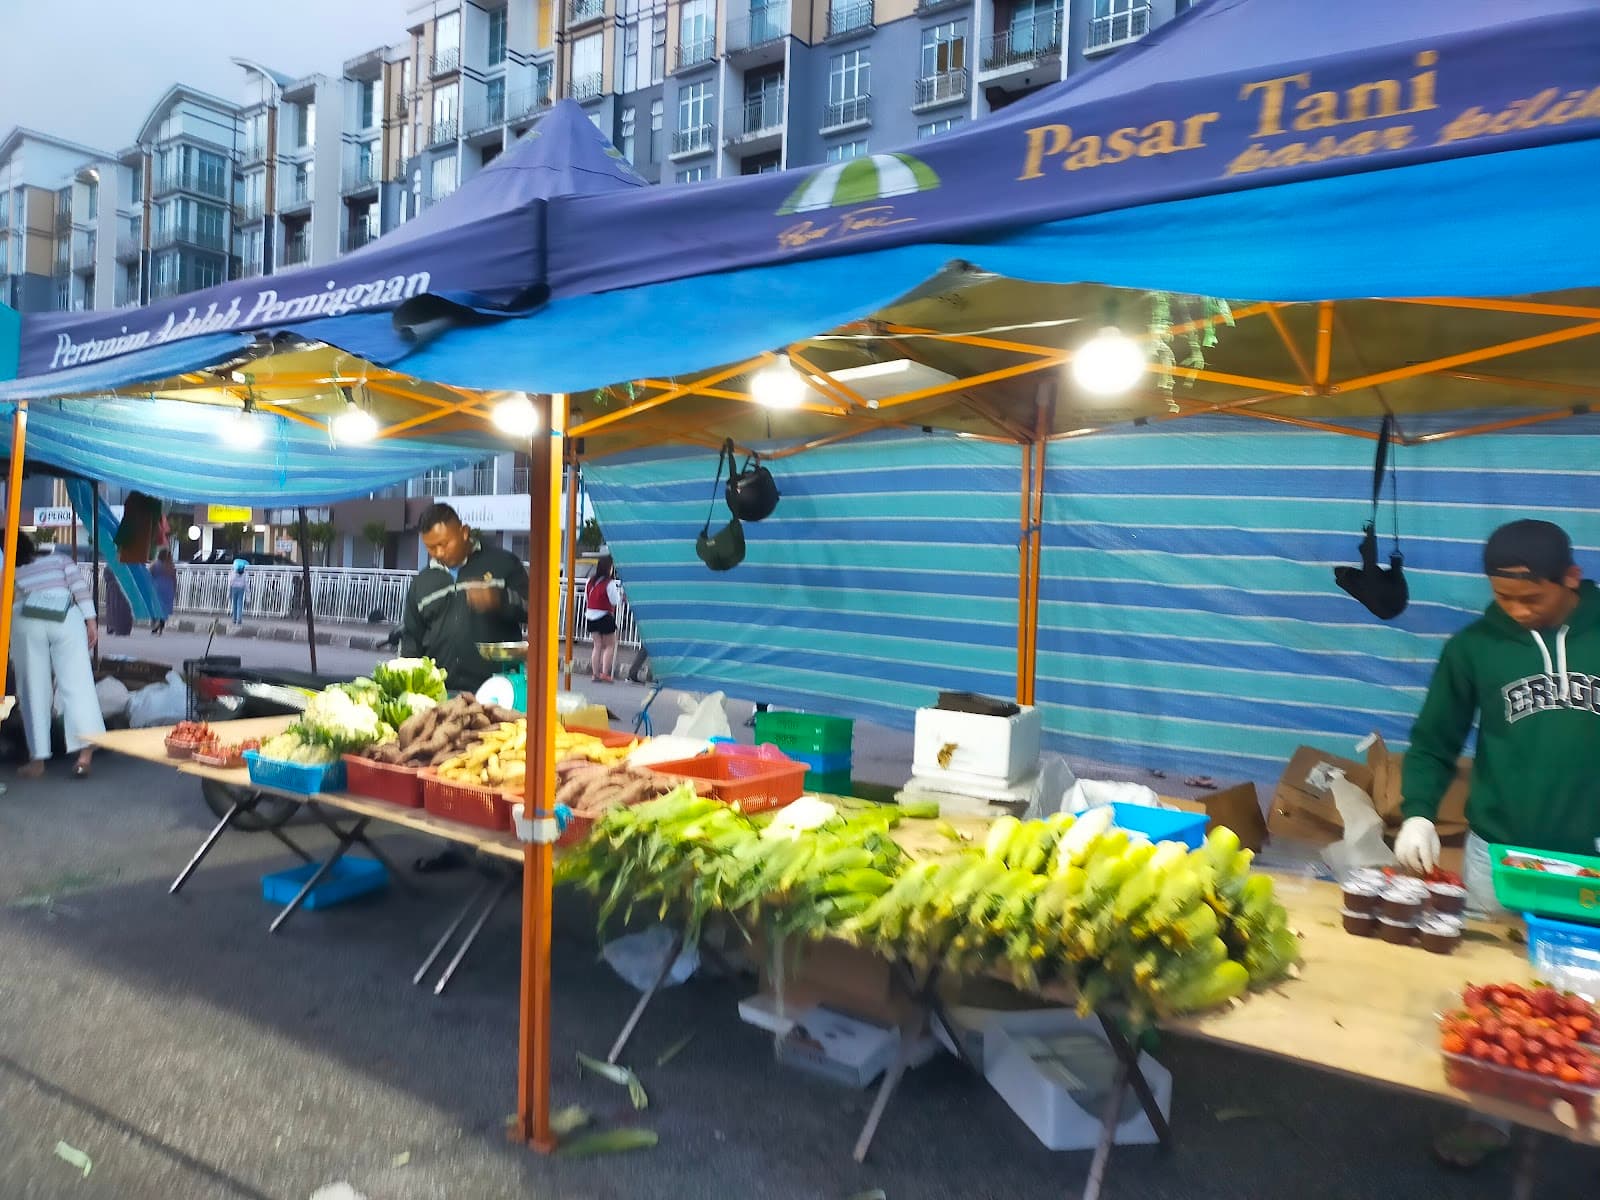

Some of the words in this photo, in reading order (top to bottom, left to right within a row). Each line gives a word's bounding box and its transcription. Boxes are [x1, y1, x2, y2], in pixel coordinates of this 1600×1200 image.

[1016, 112, 1220, 181] Pasar
[1241, 50, 1440, 138] Tani
[51, 326, 150, 368] Pertanian
[239, 272, 431, 325] Perniagaan
